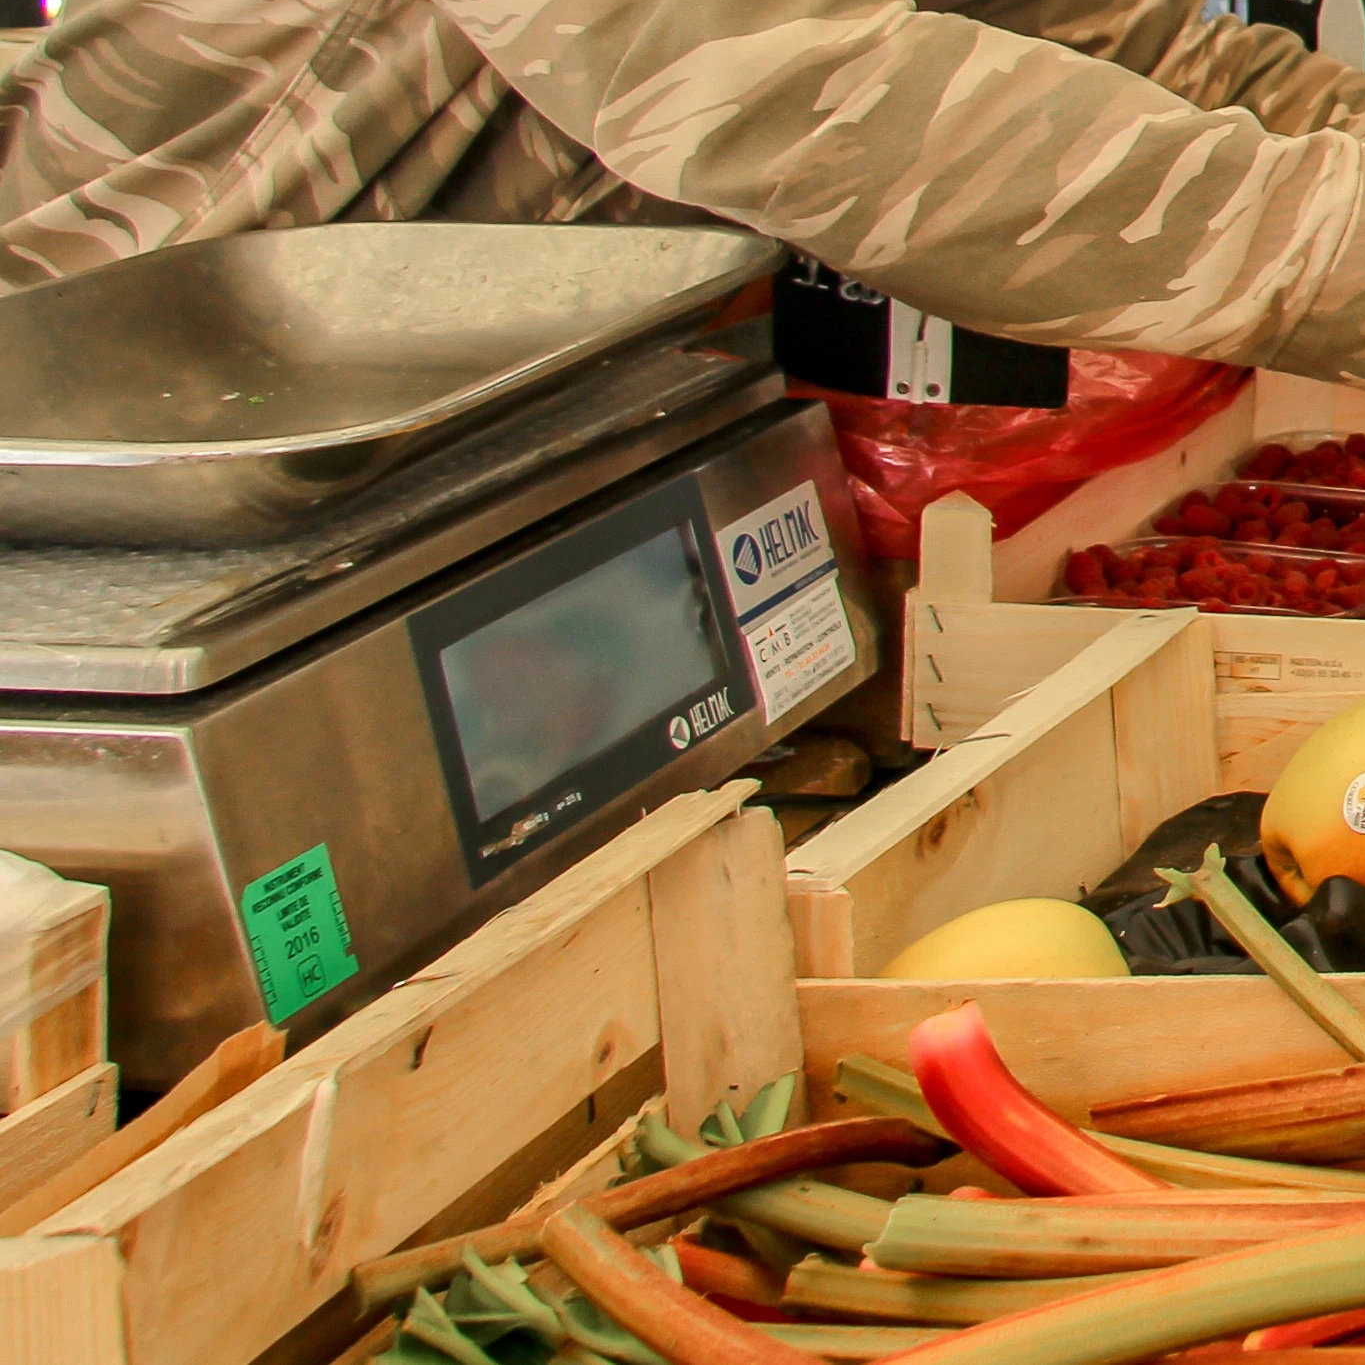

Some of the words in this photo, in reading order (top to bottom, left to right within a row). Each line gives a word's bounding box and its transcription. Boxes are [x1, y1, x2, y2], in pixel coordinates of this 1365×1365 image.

[758, 500, 819, 568] HELMAC
[689, 686, 734, 736] HELMAC
[284, 926, 320, 960] 2016
